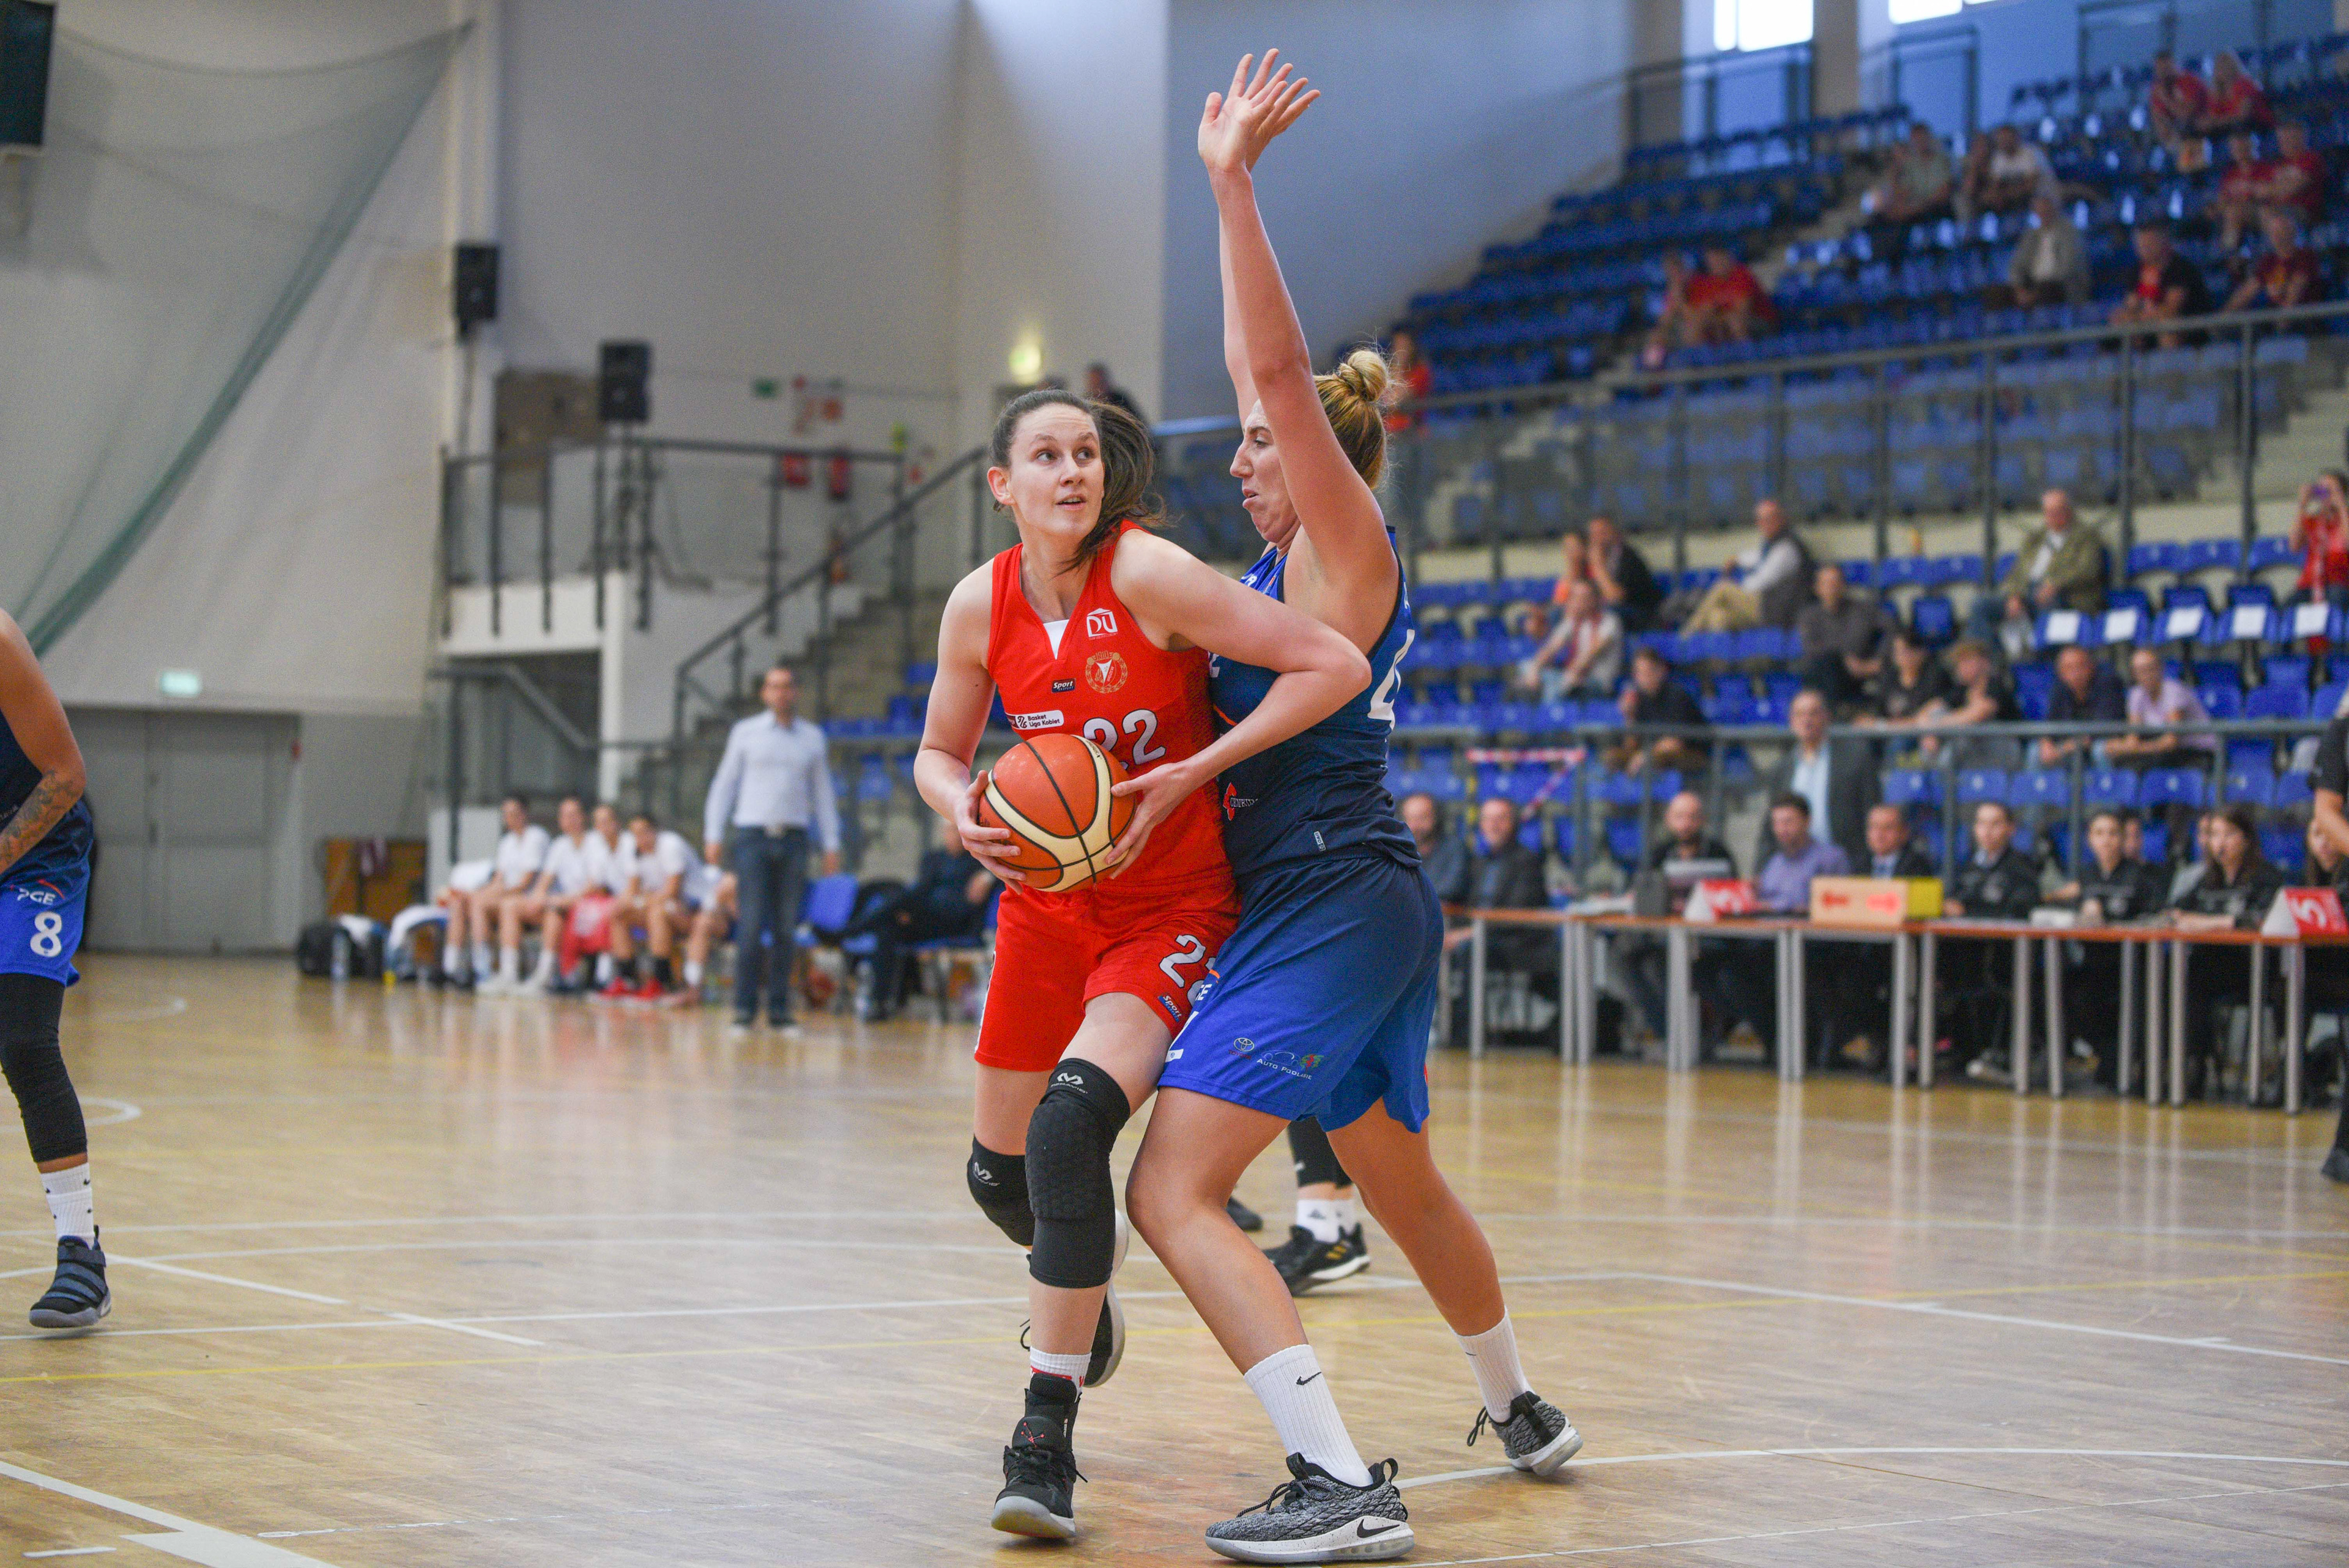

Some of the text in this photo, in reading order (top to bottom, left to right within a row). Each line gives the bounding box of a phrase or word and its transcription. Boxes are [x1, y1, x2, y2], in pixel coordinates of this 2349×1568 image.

[1053, 680, 1074, 689] Sport
[17, 887, 56, 905] PGE
[30, 910, 62, 958] 8
[1163, 994, 1182, 1018] Sport
